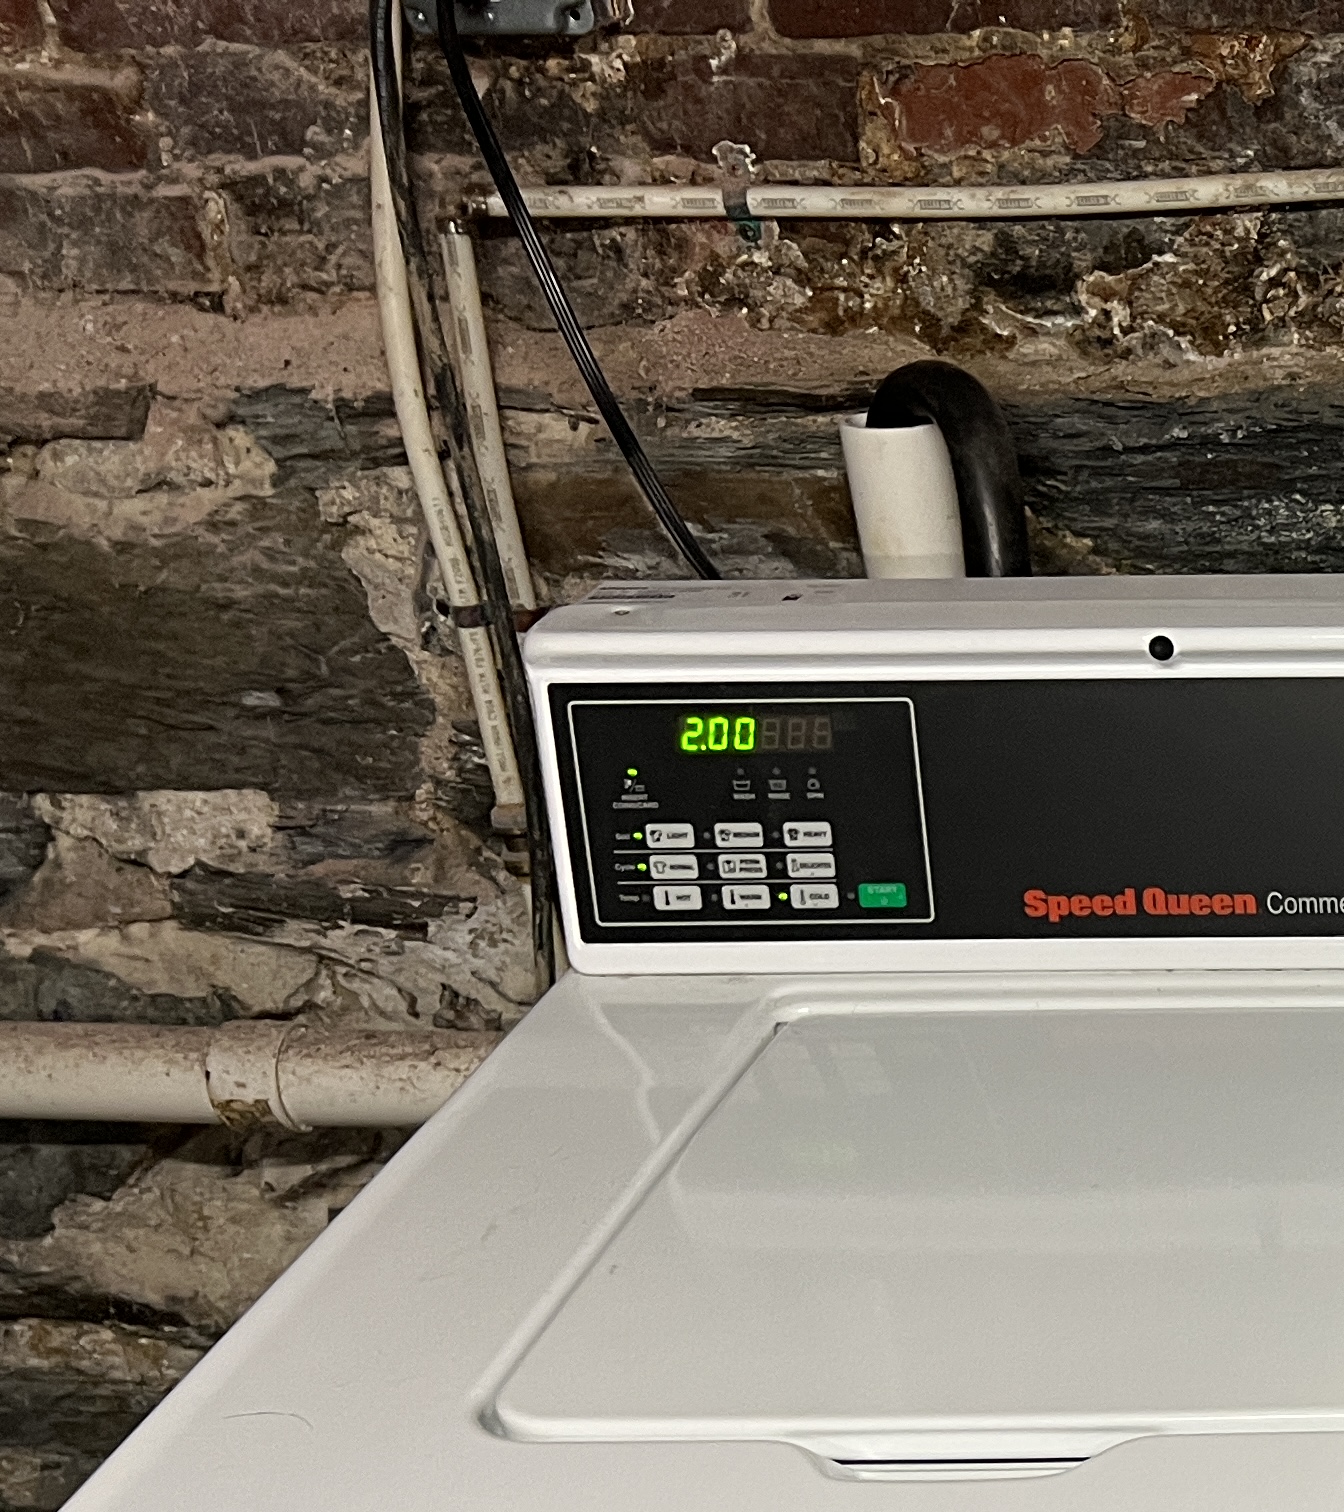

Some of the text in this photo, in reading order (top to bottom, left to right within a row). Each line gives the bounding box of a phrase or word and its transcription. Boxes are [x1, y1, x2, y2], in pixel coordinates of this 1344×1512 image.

[681, 717, 755, 751] 2.00
[1023, 887, 1137, 923] Speed
[1142, 887, 1258, 917] Queen
